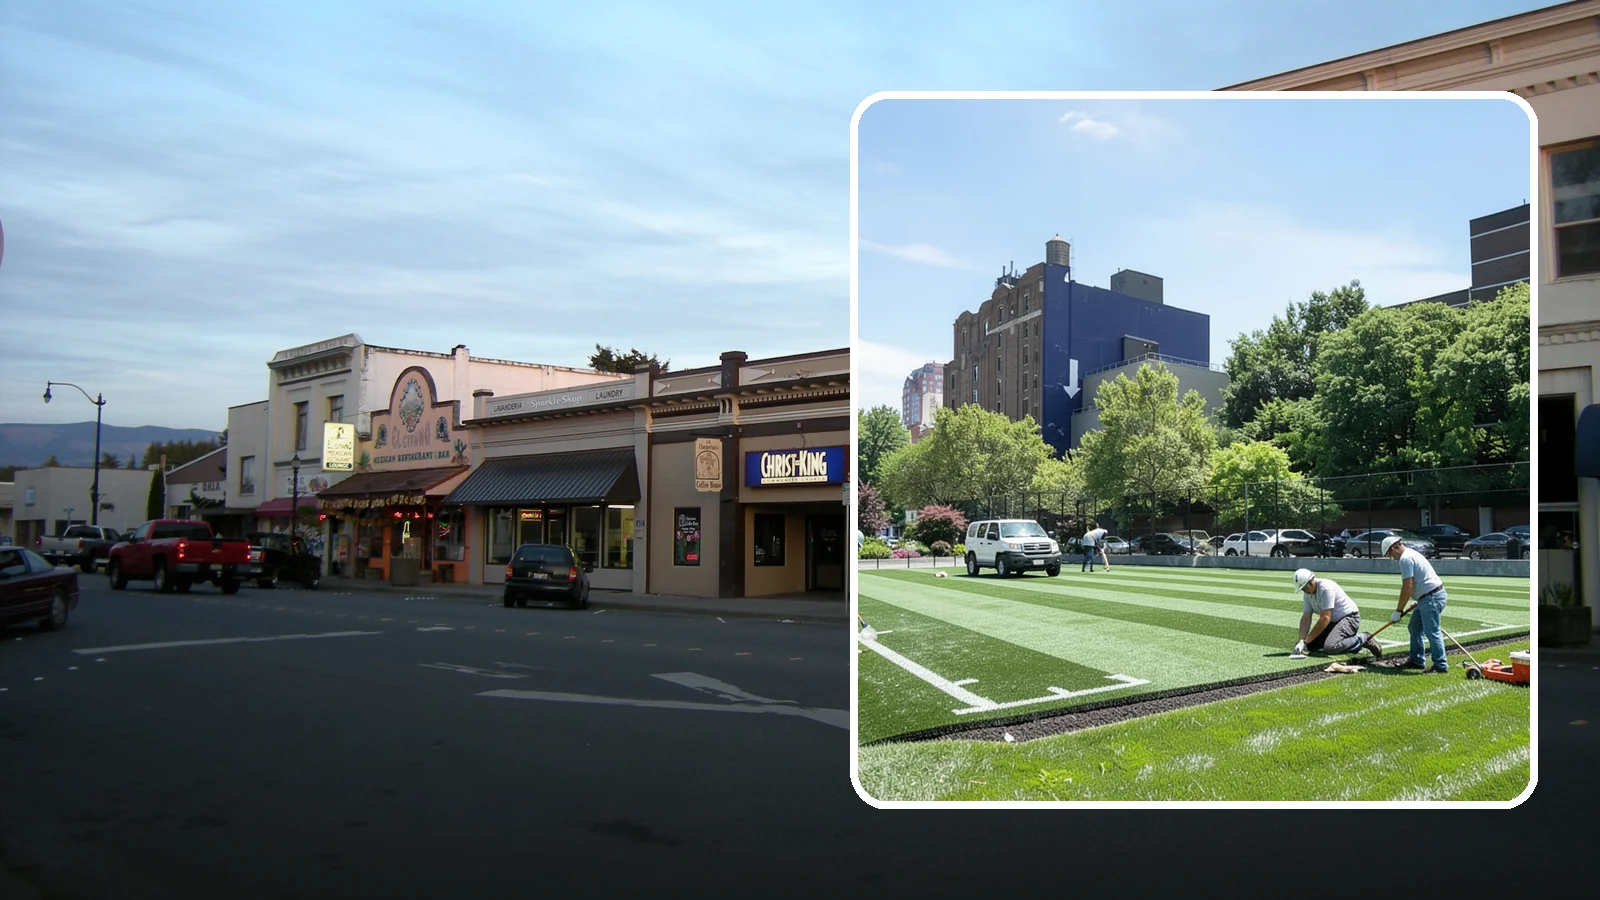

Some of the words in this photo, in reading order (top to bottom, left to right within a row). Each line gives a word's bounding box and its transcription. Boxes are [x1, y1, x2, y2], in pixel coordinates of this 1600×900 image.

[595, 389, 623, 400] LAUNDRY
[493, 402, 522, 413] LAVANDERIA
[530, 396, 561, 409] Sparkle
[561, 394, 582, 405] Shop
[397, 451, 434, 463] RESTAURANT
[437, 450, 450, 459] BAR
[761, 451, 798, 478] CHRIST
[799, 450, 827, 477] KING
